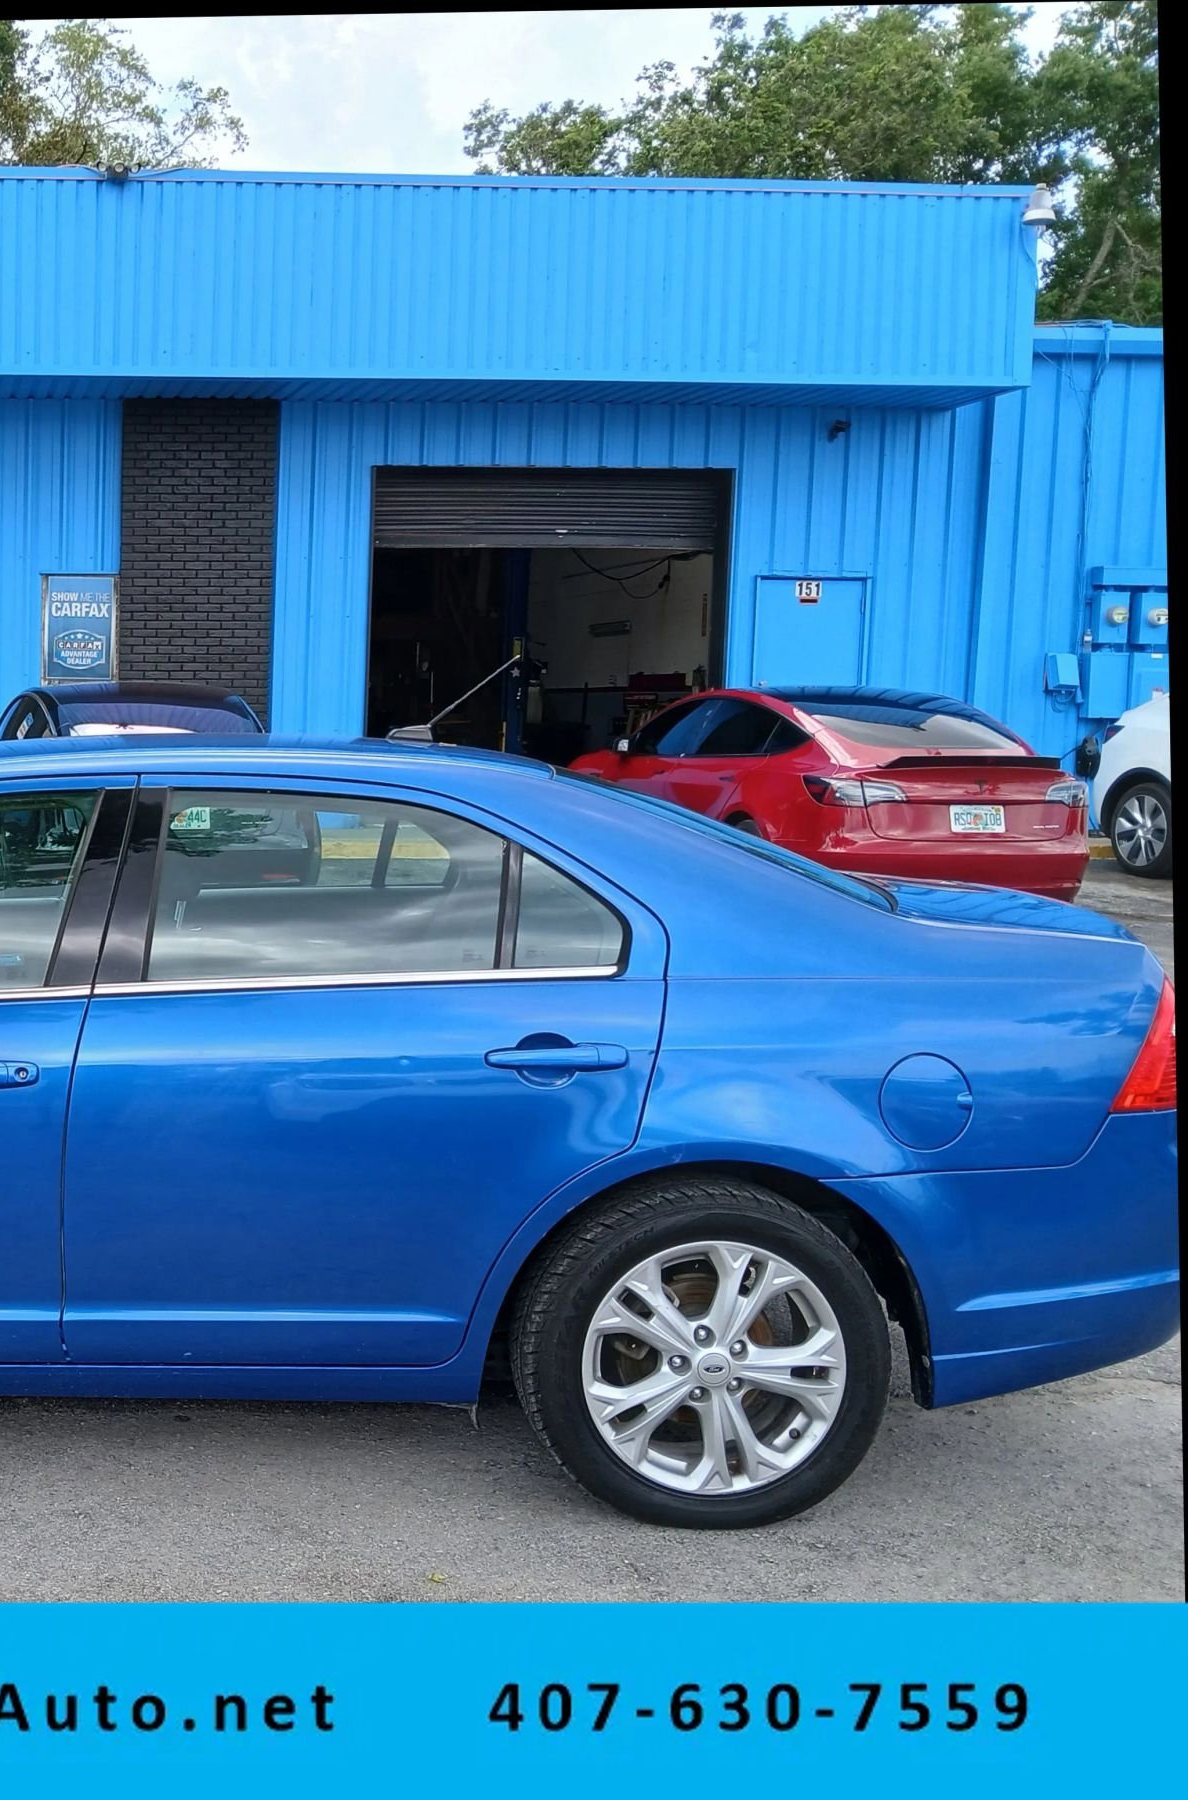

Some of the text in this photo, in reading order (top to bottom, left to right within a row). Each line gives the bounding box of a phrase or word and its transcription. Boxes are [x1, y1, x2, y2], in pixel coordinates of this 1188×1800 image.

[798, 582, 820, 597] 151
[51, 592, 110, 603] SHOW ME THE
[51, 602, 110, 618] CARFAX
[60, 650, 98, 658] ADVANTAGE
